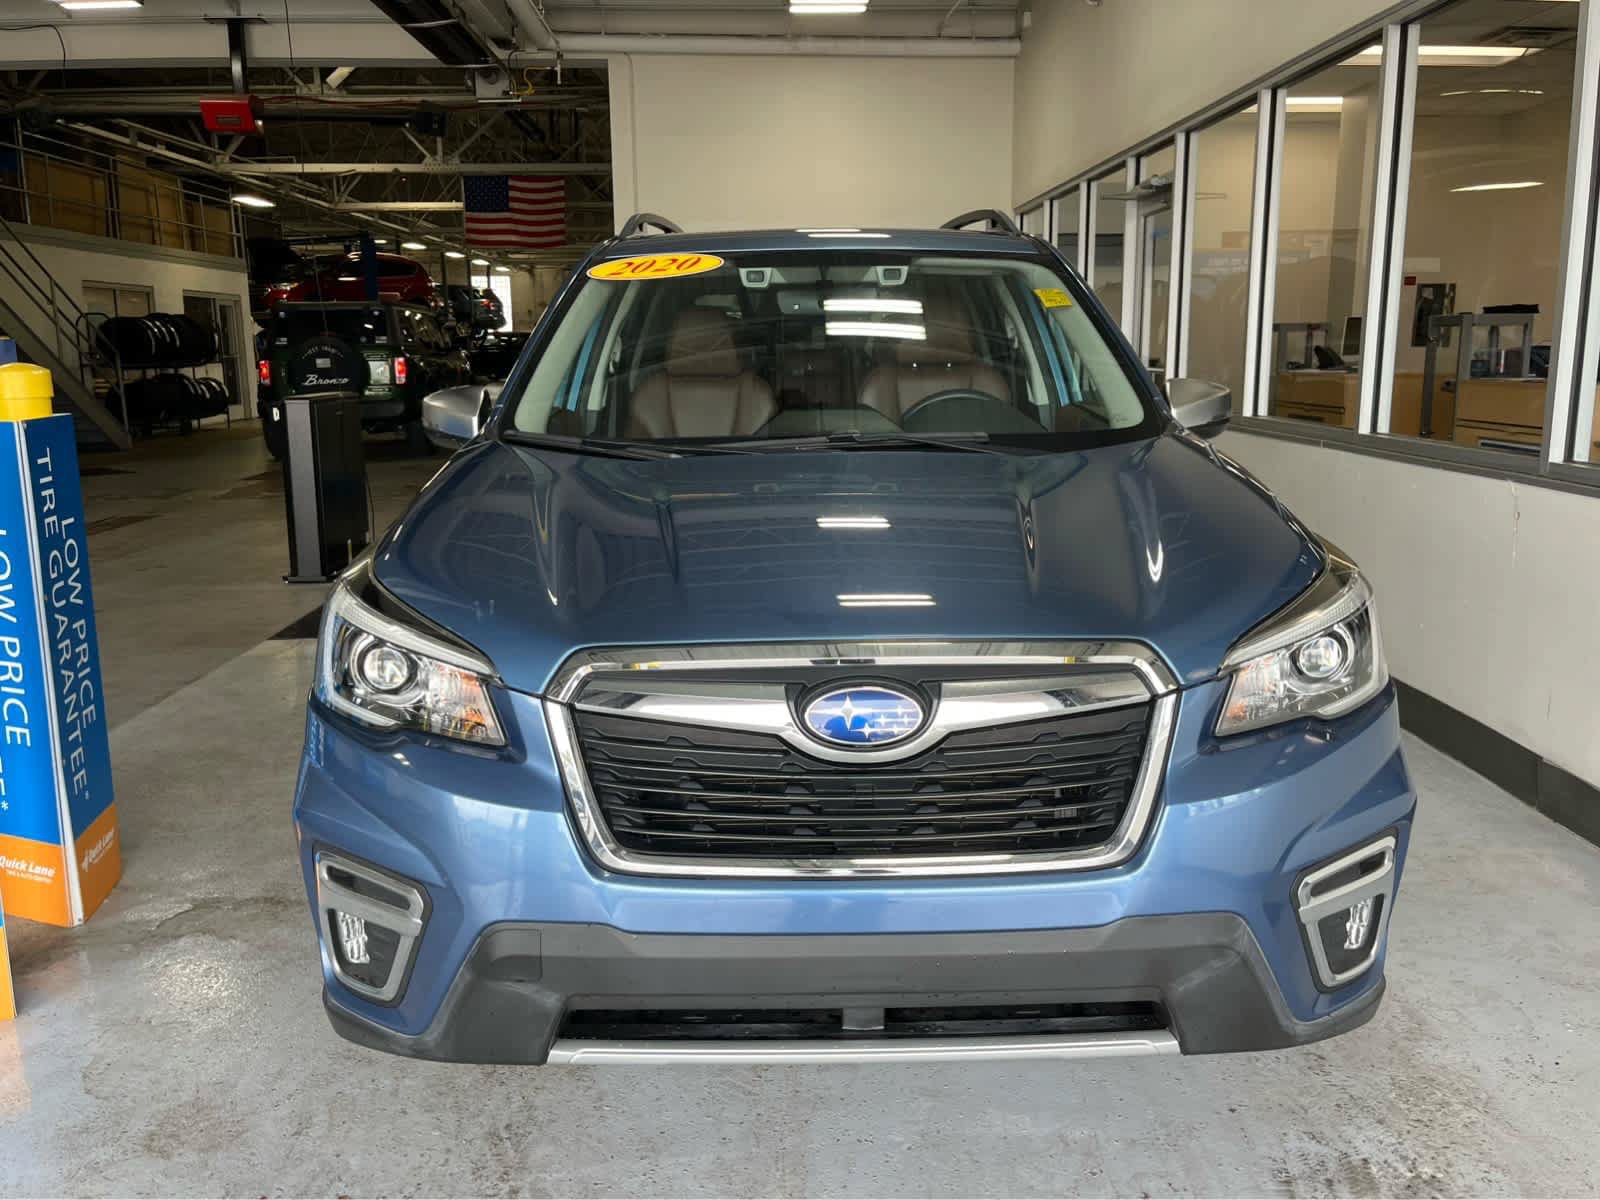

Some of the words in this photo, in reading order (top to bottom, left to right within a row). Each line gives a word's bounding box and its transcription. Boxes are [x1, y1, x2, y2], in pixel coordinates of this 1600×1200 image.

[608, 257, 702, 275] 2020
[303, 373, 349, 386] Bronco
[37, 447, 59, 539] TIRE
[0, 529, 17, 623] OW
[61, 516, 84, 605] LOW
[73, 617, 96, 728] PRICE
[0, 635, 31, 747] PRICE
[0, 855, 27, 870] Quick
[28, 861, 55, 877] Lane
